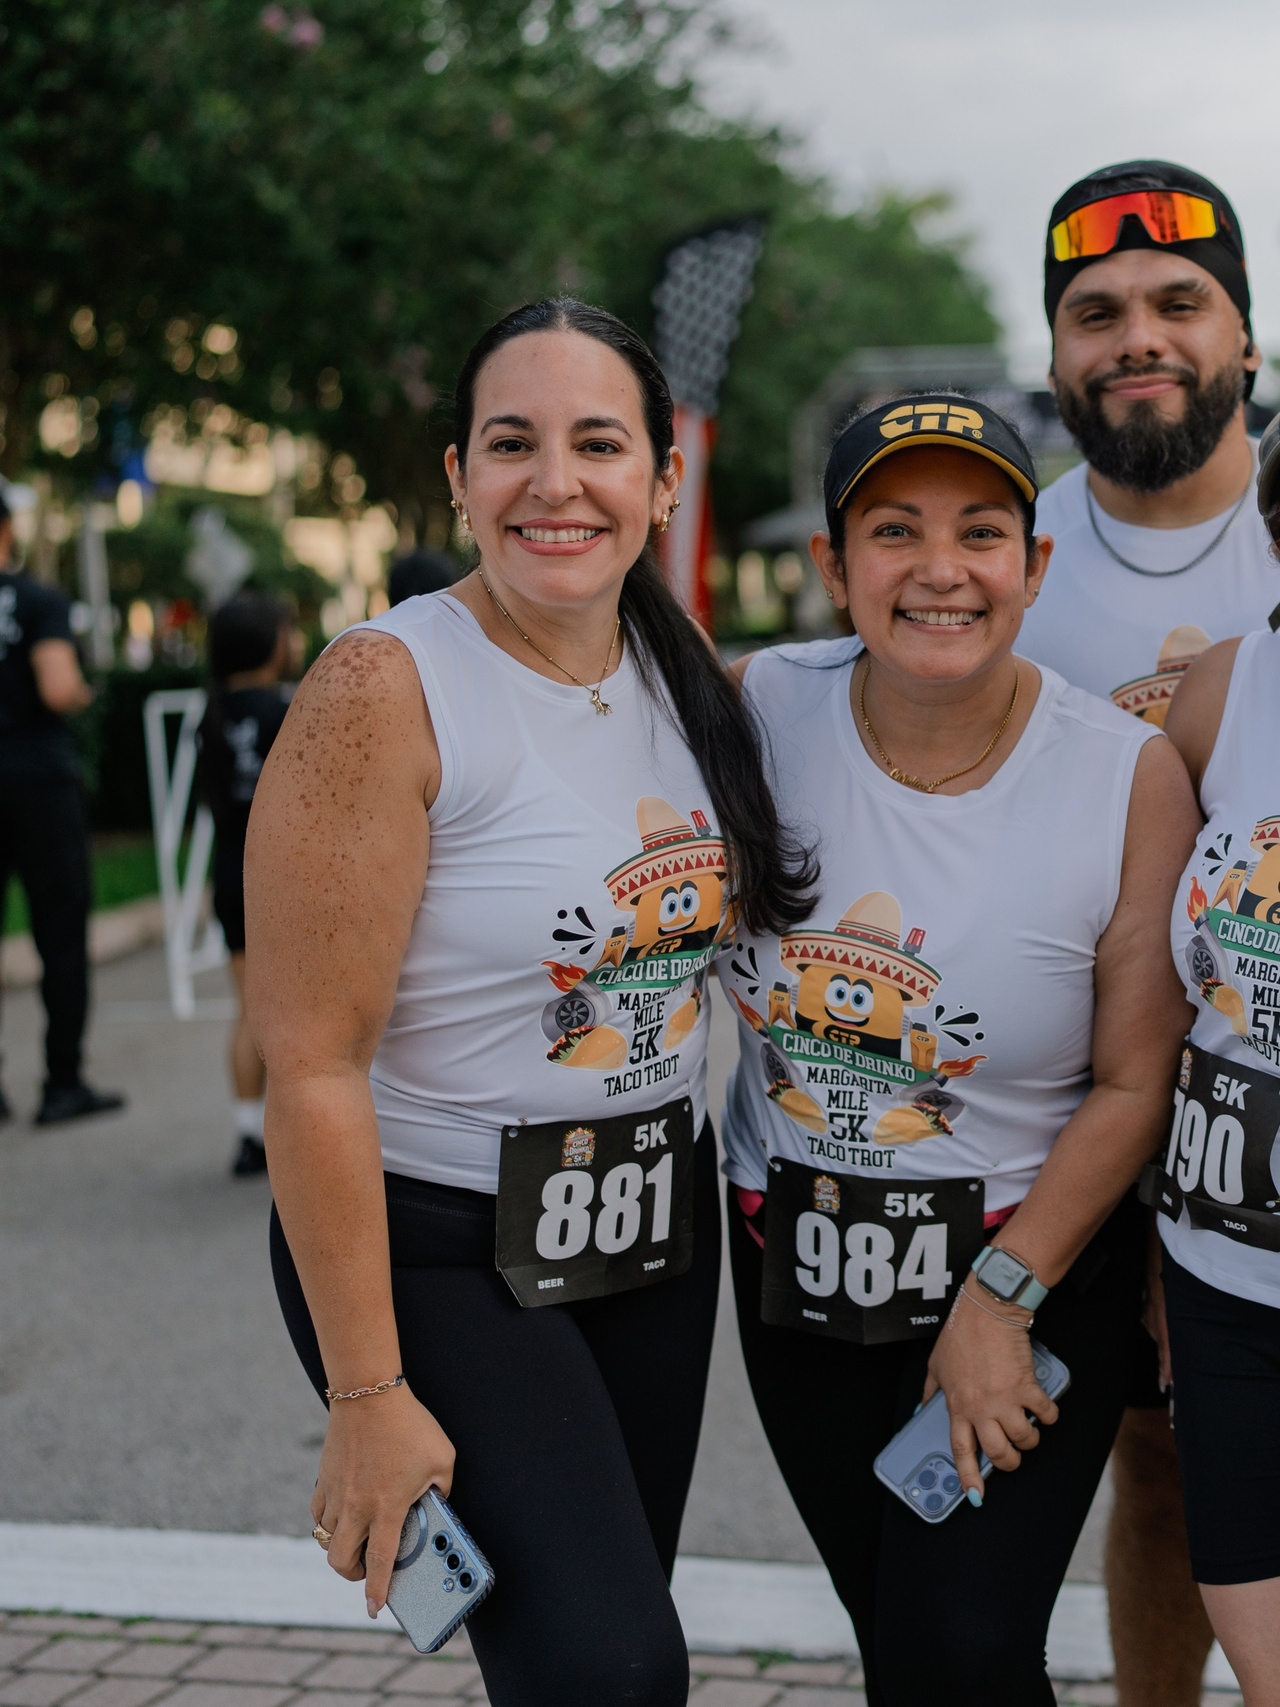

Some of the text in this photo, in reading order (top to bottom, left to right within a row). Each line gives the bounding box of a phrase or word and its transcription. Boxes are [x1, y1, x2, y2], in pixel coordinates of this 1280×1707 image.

[879, 403, 984, 439] CTP
[1217, 917, 1266, 949] CINCO
[645, 959, 668, 981] DE
[633, 1002, 665, 1031] MILE
[629, 1024, 663, 1065] 5K
[782, 1032, 916, 1082] CINCO DE DRINKO
[604, 1053, 680, 1098] TACO TROT
[806, 1066, 893, 1095] MARGARITA
[826, 1089, 869, 1111] MILE
[1212, 1073, 1252, 1111] 5K
[634, 1118, 668, 1152] 5K
[828, 1112, 869, 1143] 5K
[807, 1136, 896, 1168] TACO TROT
[536, 1152, 673, 1260] 881
[883, 1192, 935, 1218] 5K
[1223, 1219, 1248, 1232] TACO
[643, 1258, 666, 1271] TACO
[795, 1211, 952, 1308] 984
[537, 1277, 564, 1290] BEER
[802, 1308, 828, 1322] BEER
[910, 1315, 939, 1326] TACO
